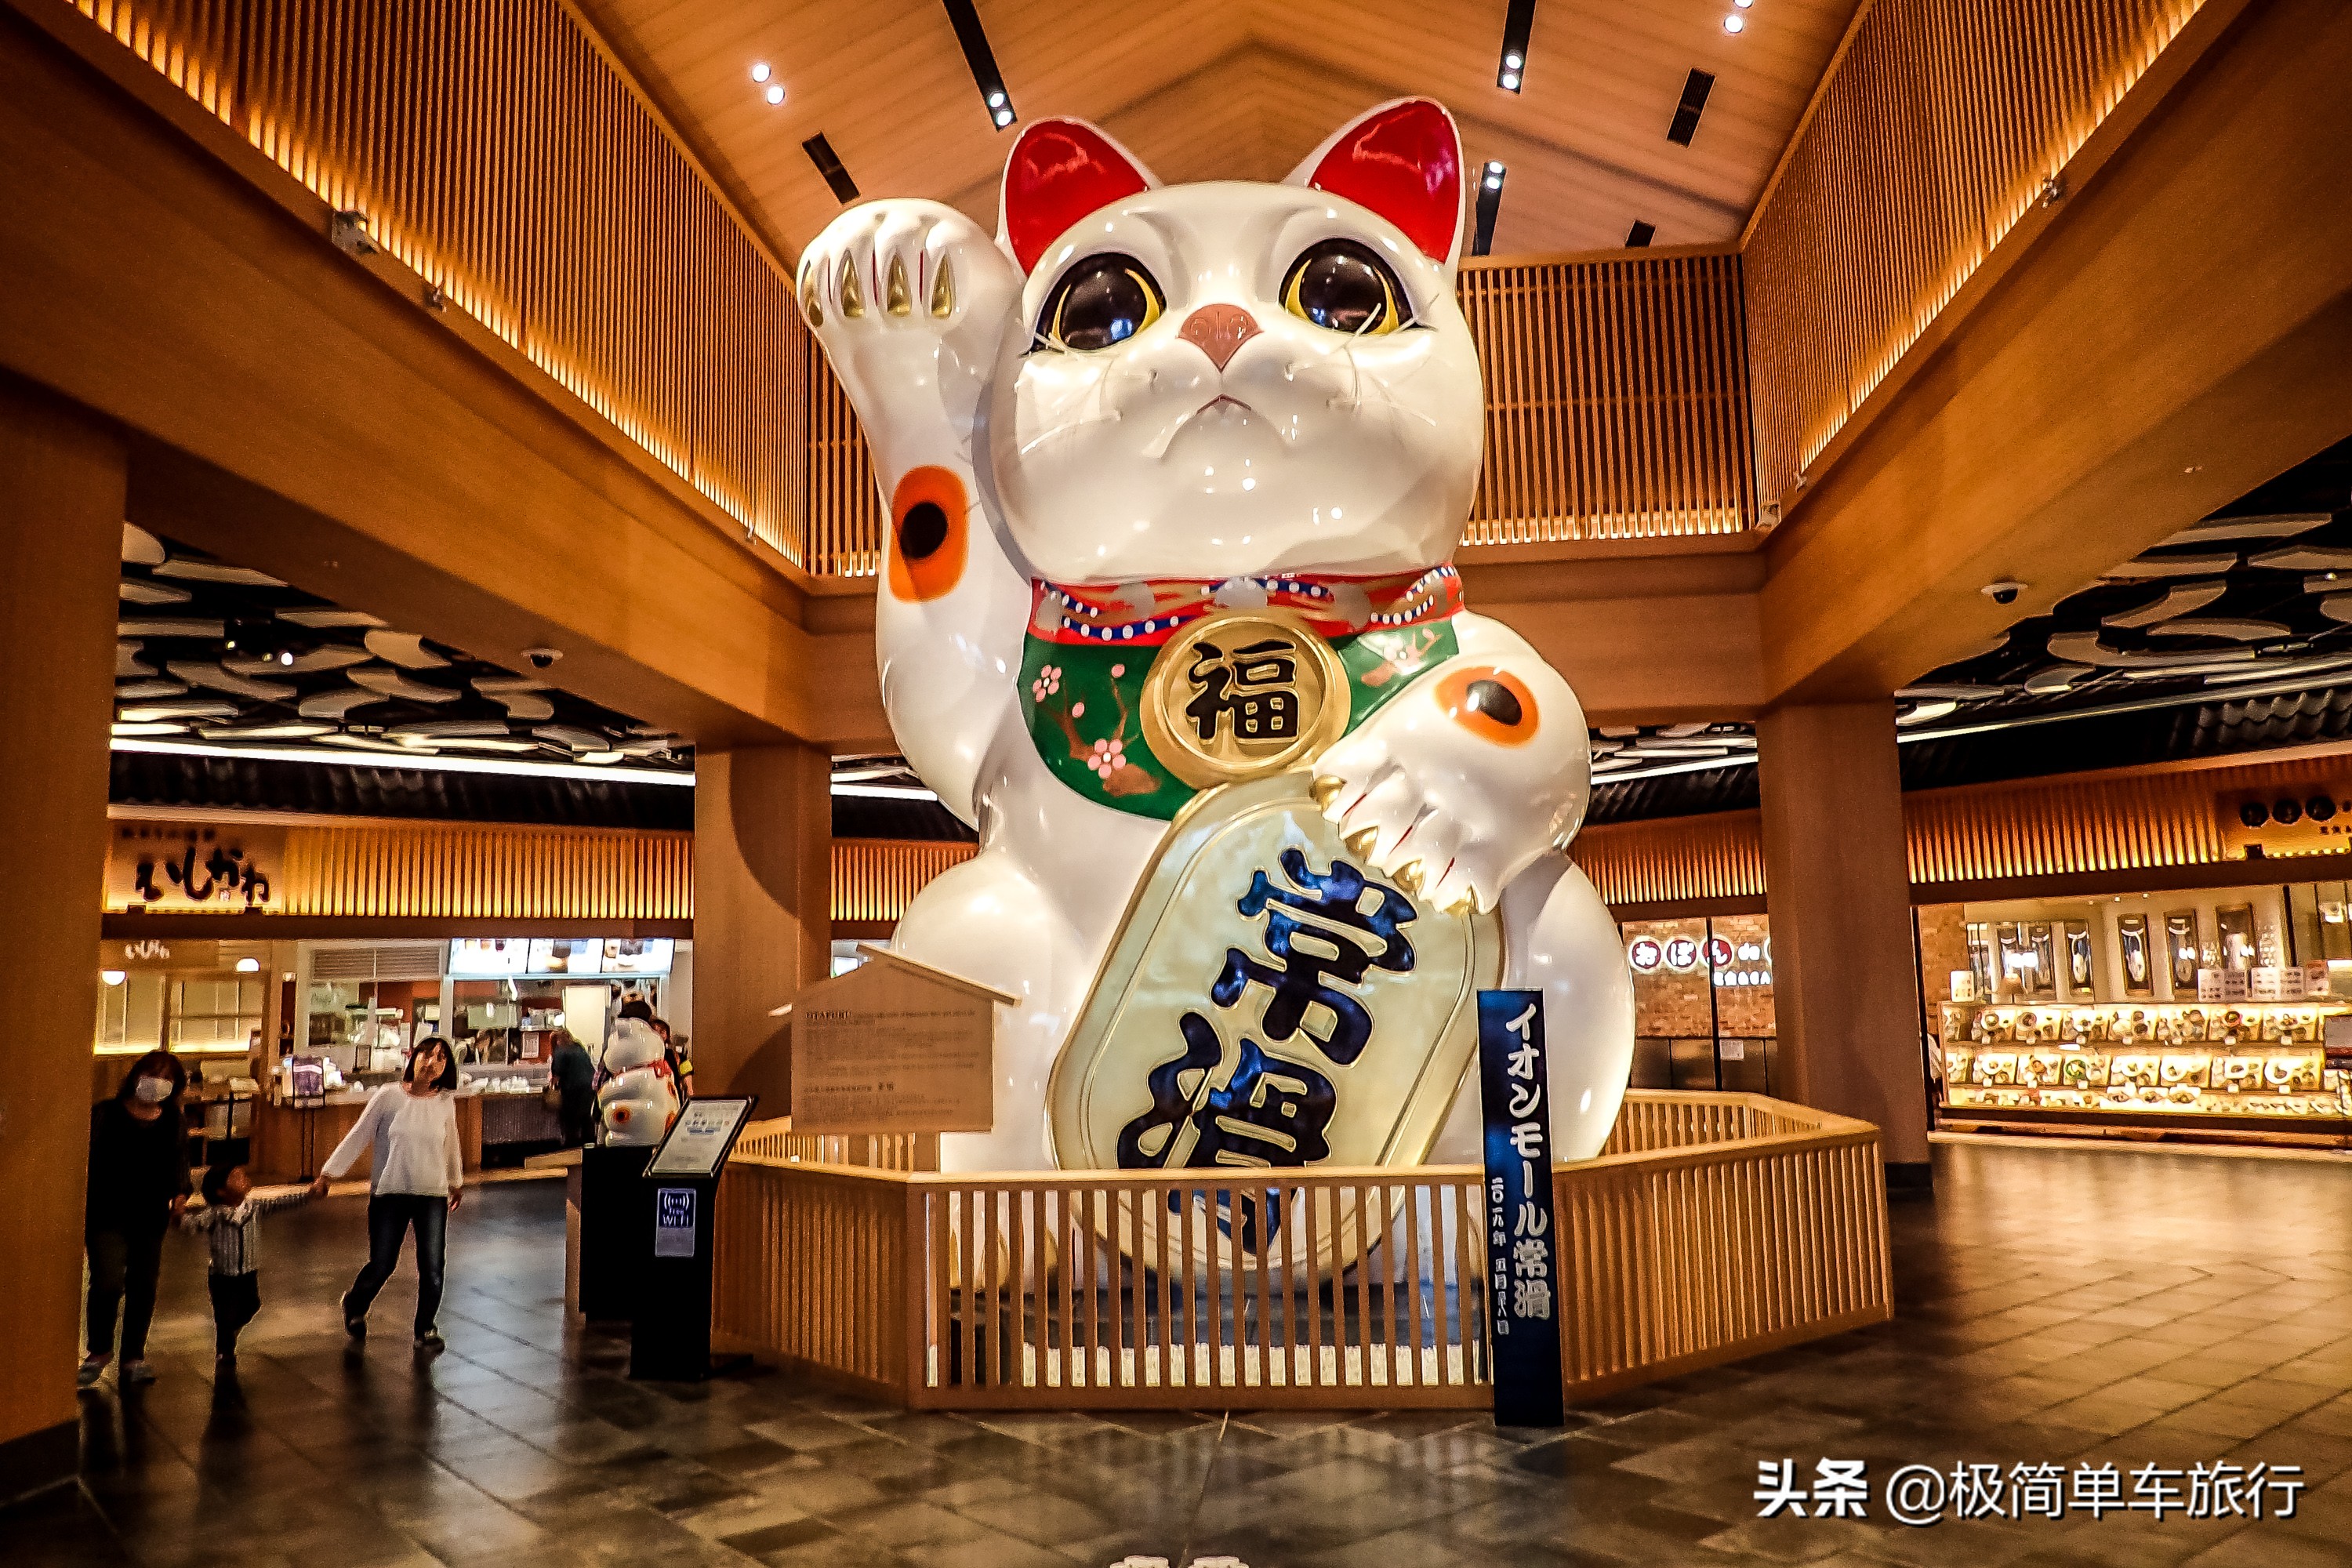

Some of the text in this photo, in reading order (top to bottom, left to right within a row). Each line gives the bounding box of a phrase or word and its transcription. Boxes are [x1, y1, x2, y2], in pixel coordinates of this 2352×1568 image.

[1185, 637, 1299, 743] 福
[1116, 845, 1420, 1254] 常滑
[1504, 1003, 1551, 1320] イオンモール常滑
